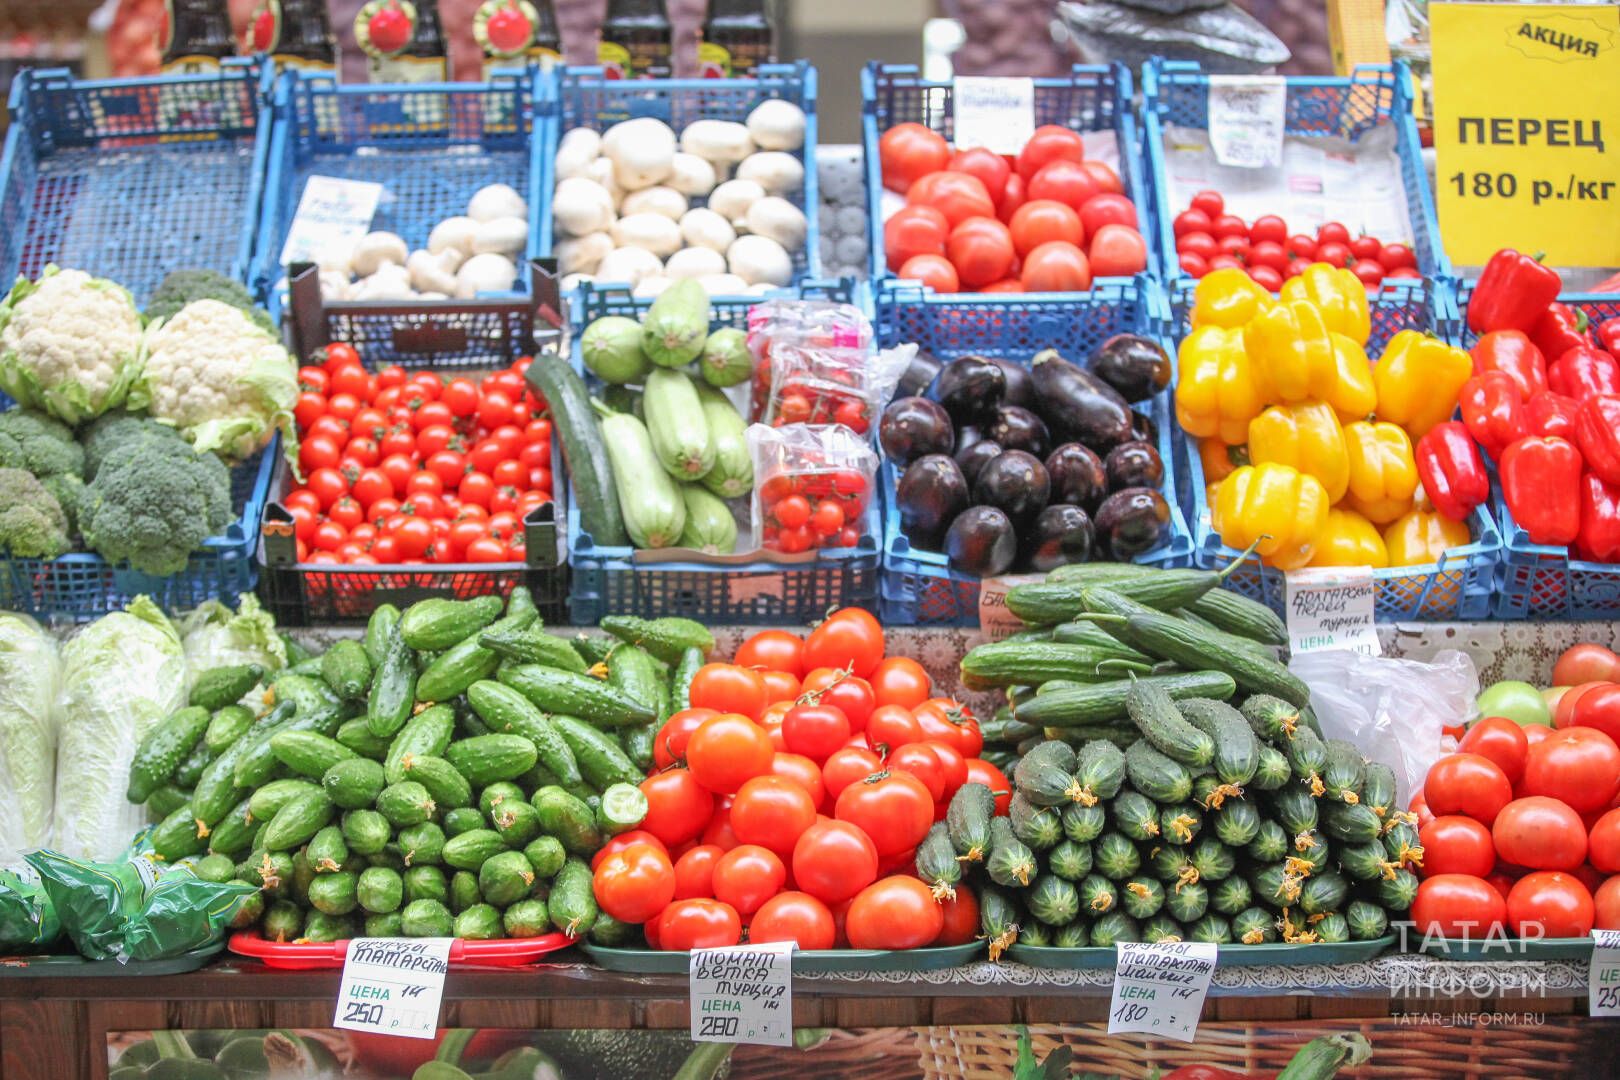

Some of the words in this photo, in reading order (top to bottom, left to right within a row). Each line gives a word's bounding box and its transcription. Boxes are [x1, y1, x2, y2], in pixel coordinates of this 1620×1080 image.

[1517, 22, 1599, 58] АКЦИЯ
[1458, 117, 1605, 153] ПЕРЕЦ
[1450, 172, 1517, 198] 180
[1532, 174, 1617, 206] р./кг
[1300, 635, 1335, 650] ЦЕНА
[350, 985, 391, 1000] ЦЕНА
[1120, 986, 1157, 1000] ЦЕНА
[1598, 986, 1620, 1008] 25
[343, 1002, 384, 1025] 250
[702, 1000, 742, 1013] ЦЕНА
[1114, 1003, 1148, 1023] 180
[699, 1016, 739, 1036] 280
